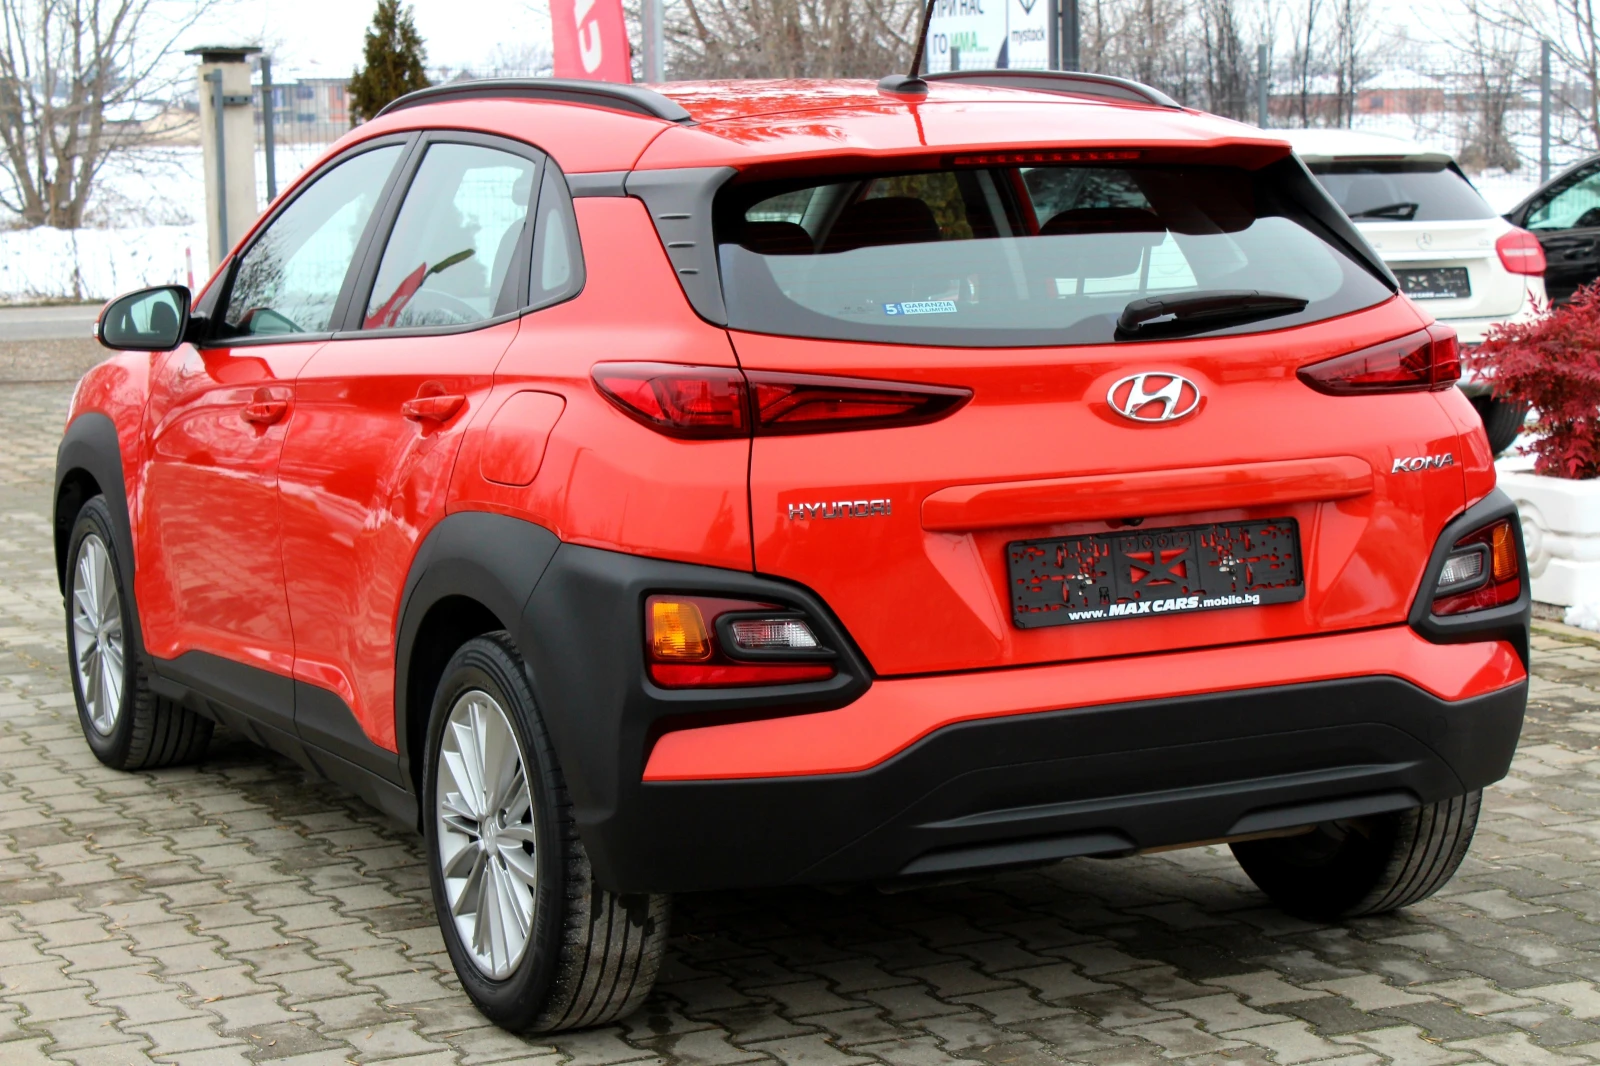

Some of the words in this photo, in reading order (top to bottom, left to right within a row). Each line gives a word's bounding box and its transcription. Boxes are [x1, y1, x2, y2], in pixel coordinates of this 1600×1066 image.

[885, 303, 898, 315] 5
[904, 301, 953, 309] GARANZIA
[1391, 452, 1454, 474] KONA
[788, 499, 891, 520] HYUNDAI
